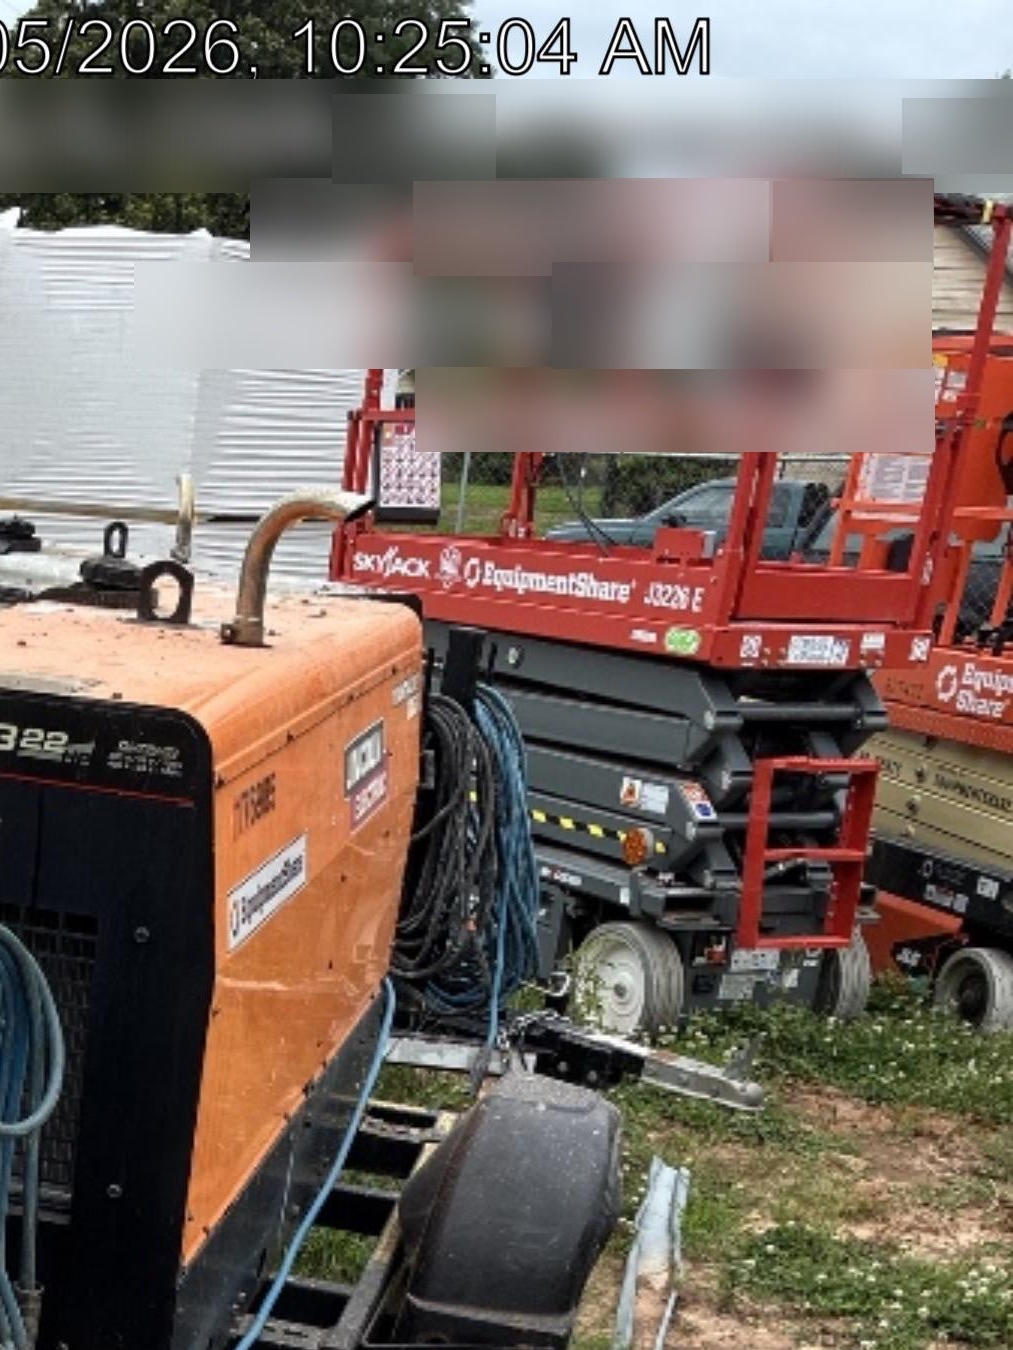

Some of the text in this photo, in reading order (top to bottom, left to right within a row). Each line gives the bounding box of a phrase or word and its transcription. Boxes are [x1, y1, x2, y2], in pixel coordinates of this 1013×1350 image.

[353, 546, 430, 578] SKYJACK
[482, 561, 631, 603] EquipmentShare
[691, 587, 705, 612] E
[962, 662, 1013, 697] Equip
